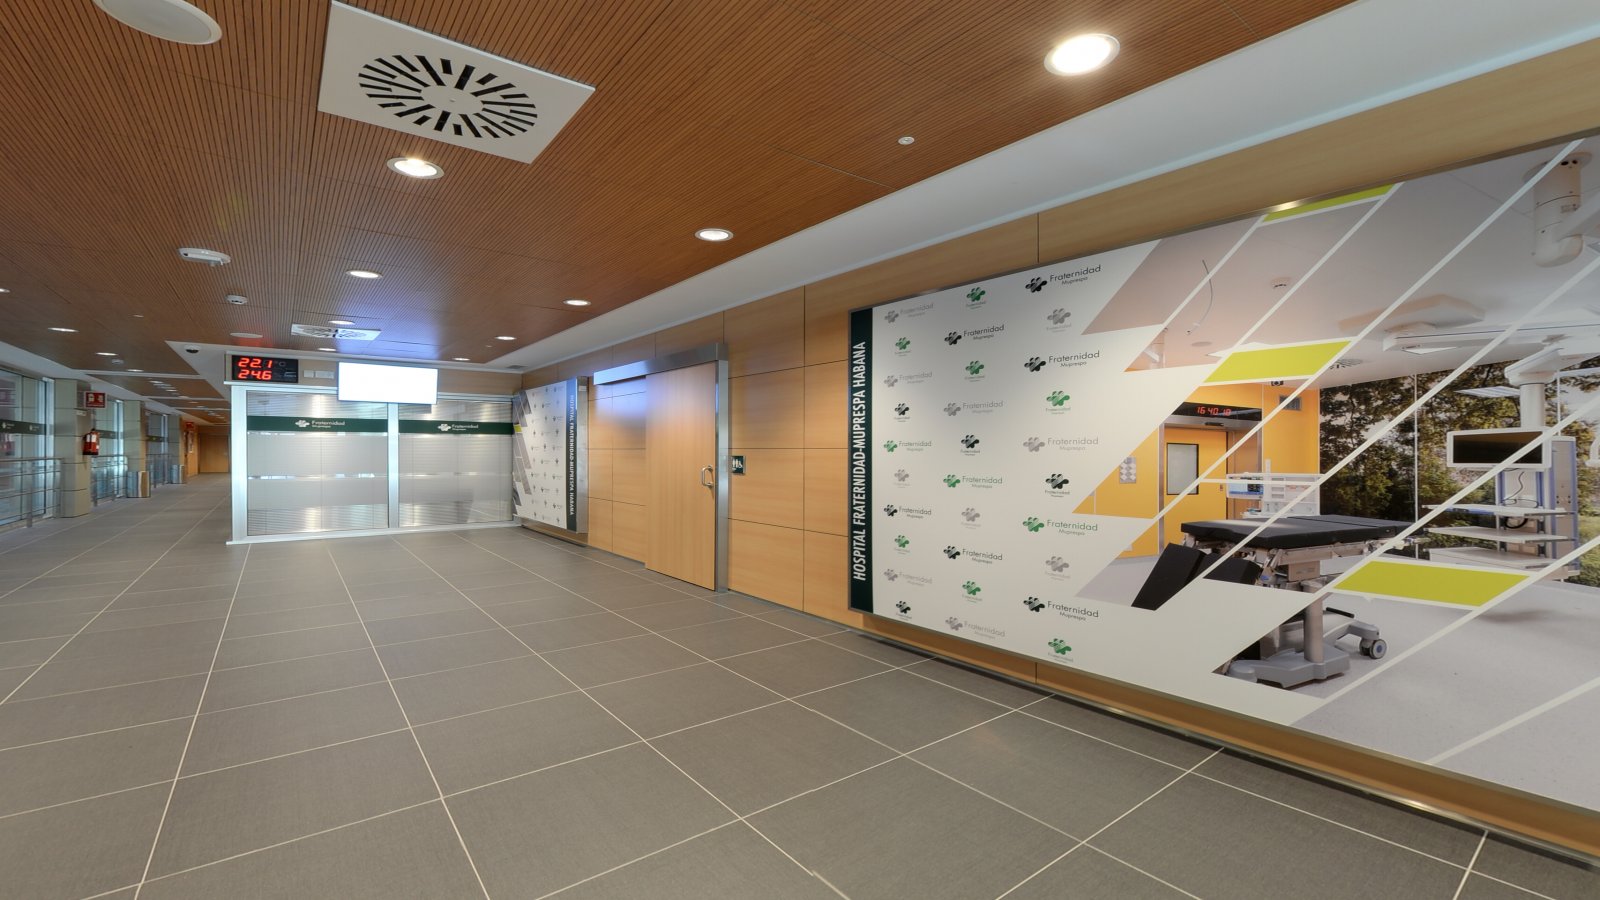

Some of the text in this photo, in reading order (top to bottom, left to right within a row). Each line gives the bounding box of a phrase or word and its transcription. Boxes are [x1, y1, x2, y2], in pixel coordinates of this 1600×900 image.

[1049, 264, 1102, 282] Fraternidad
[963, 324, 1005, 337] Fraternidad
[1048, 350, 1100, 363] Fraternidad
[962, 400, 1004, 409] Fraternidad
[1047, 436, 1099, 445] Fraternidad
[852, 341, 866, 581] HOSPITAL FRATERNIDAD-MUPRESPA HABANA
[962, 475, 1003, 484] Fraternidad
[1047, 519, 1099, 531] Fraternidad
[962, 548, 1003, 561] Fraternidad
[1047, 600, 1099, 618] Fraternidad
